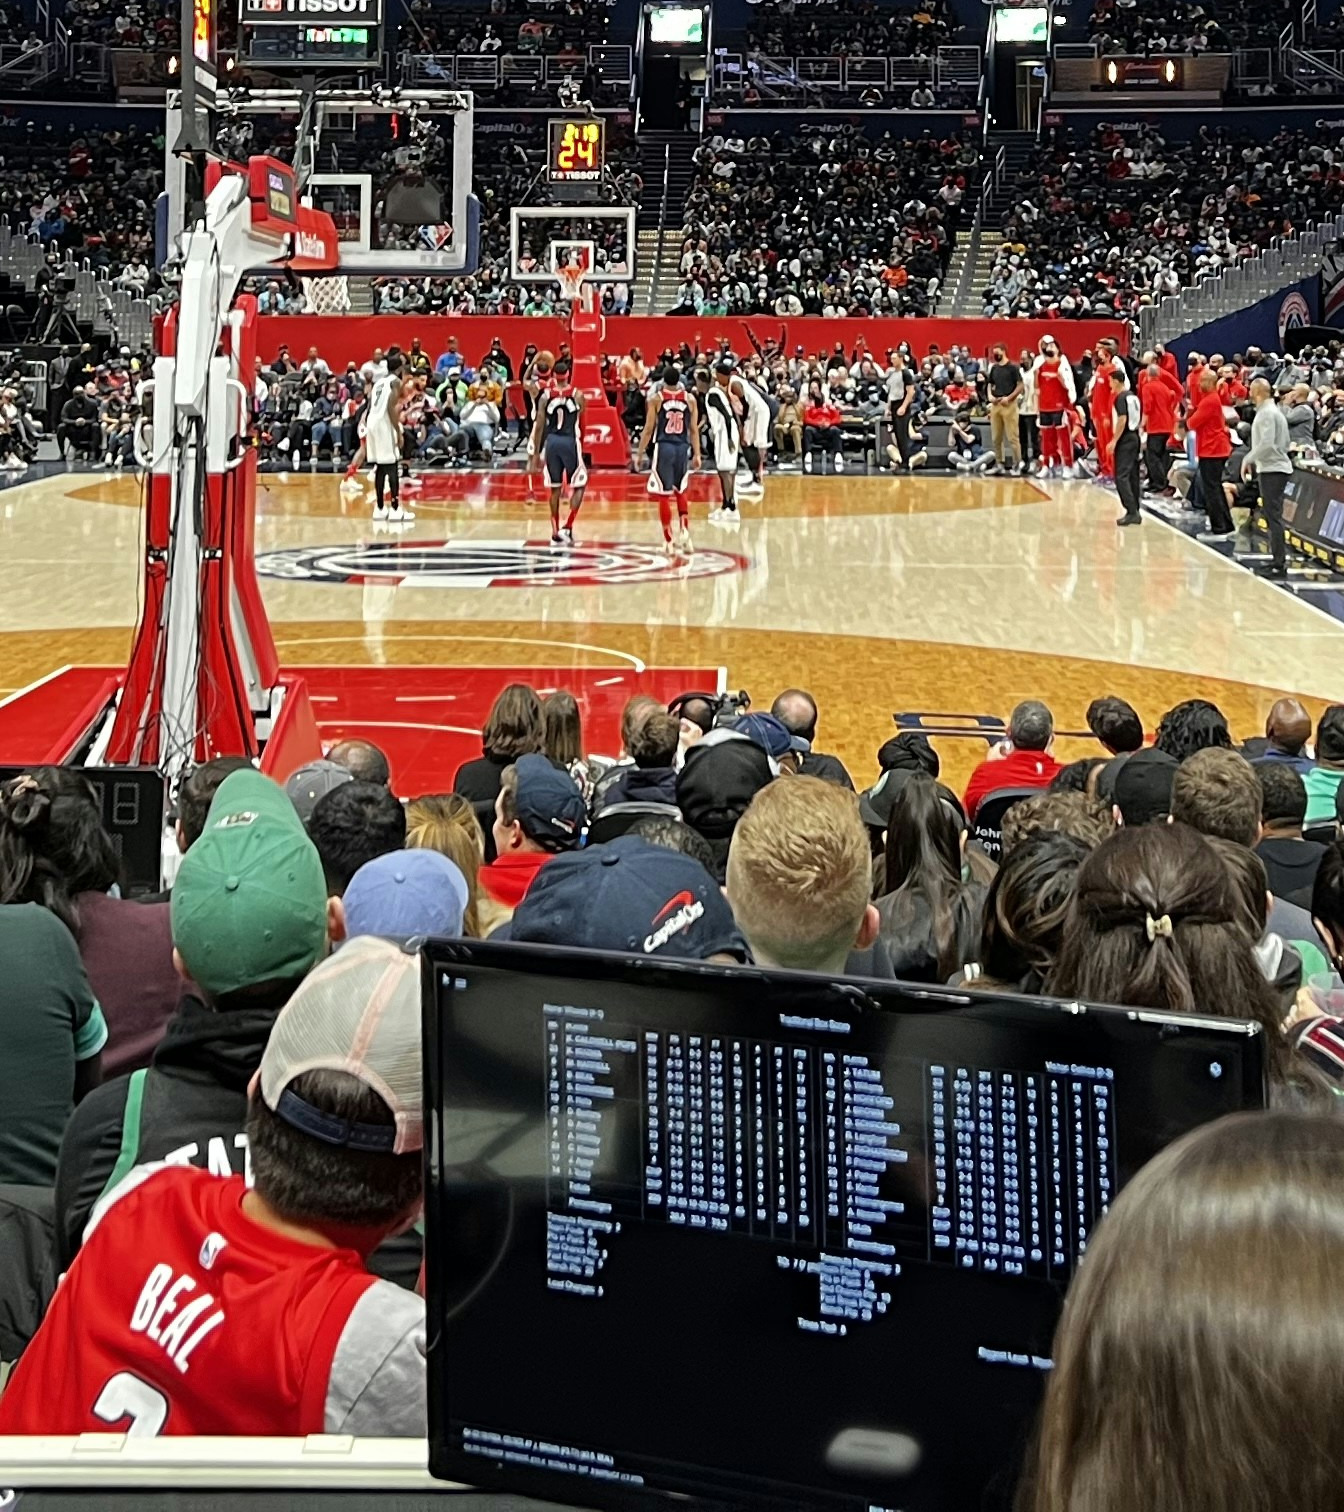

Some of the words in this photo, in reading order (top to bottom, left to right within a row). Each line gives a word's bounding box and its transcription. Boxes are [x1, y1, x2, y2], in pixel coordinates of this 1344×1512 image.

[557, 140, 593, 168] 24
[565, 171, 600, 180] TISSOT
[665, 411, 684, 434] 26
[129, 1262, 227, 1374] BEAL
